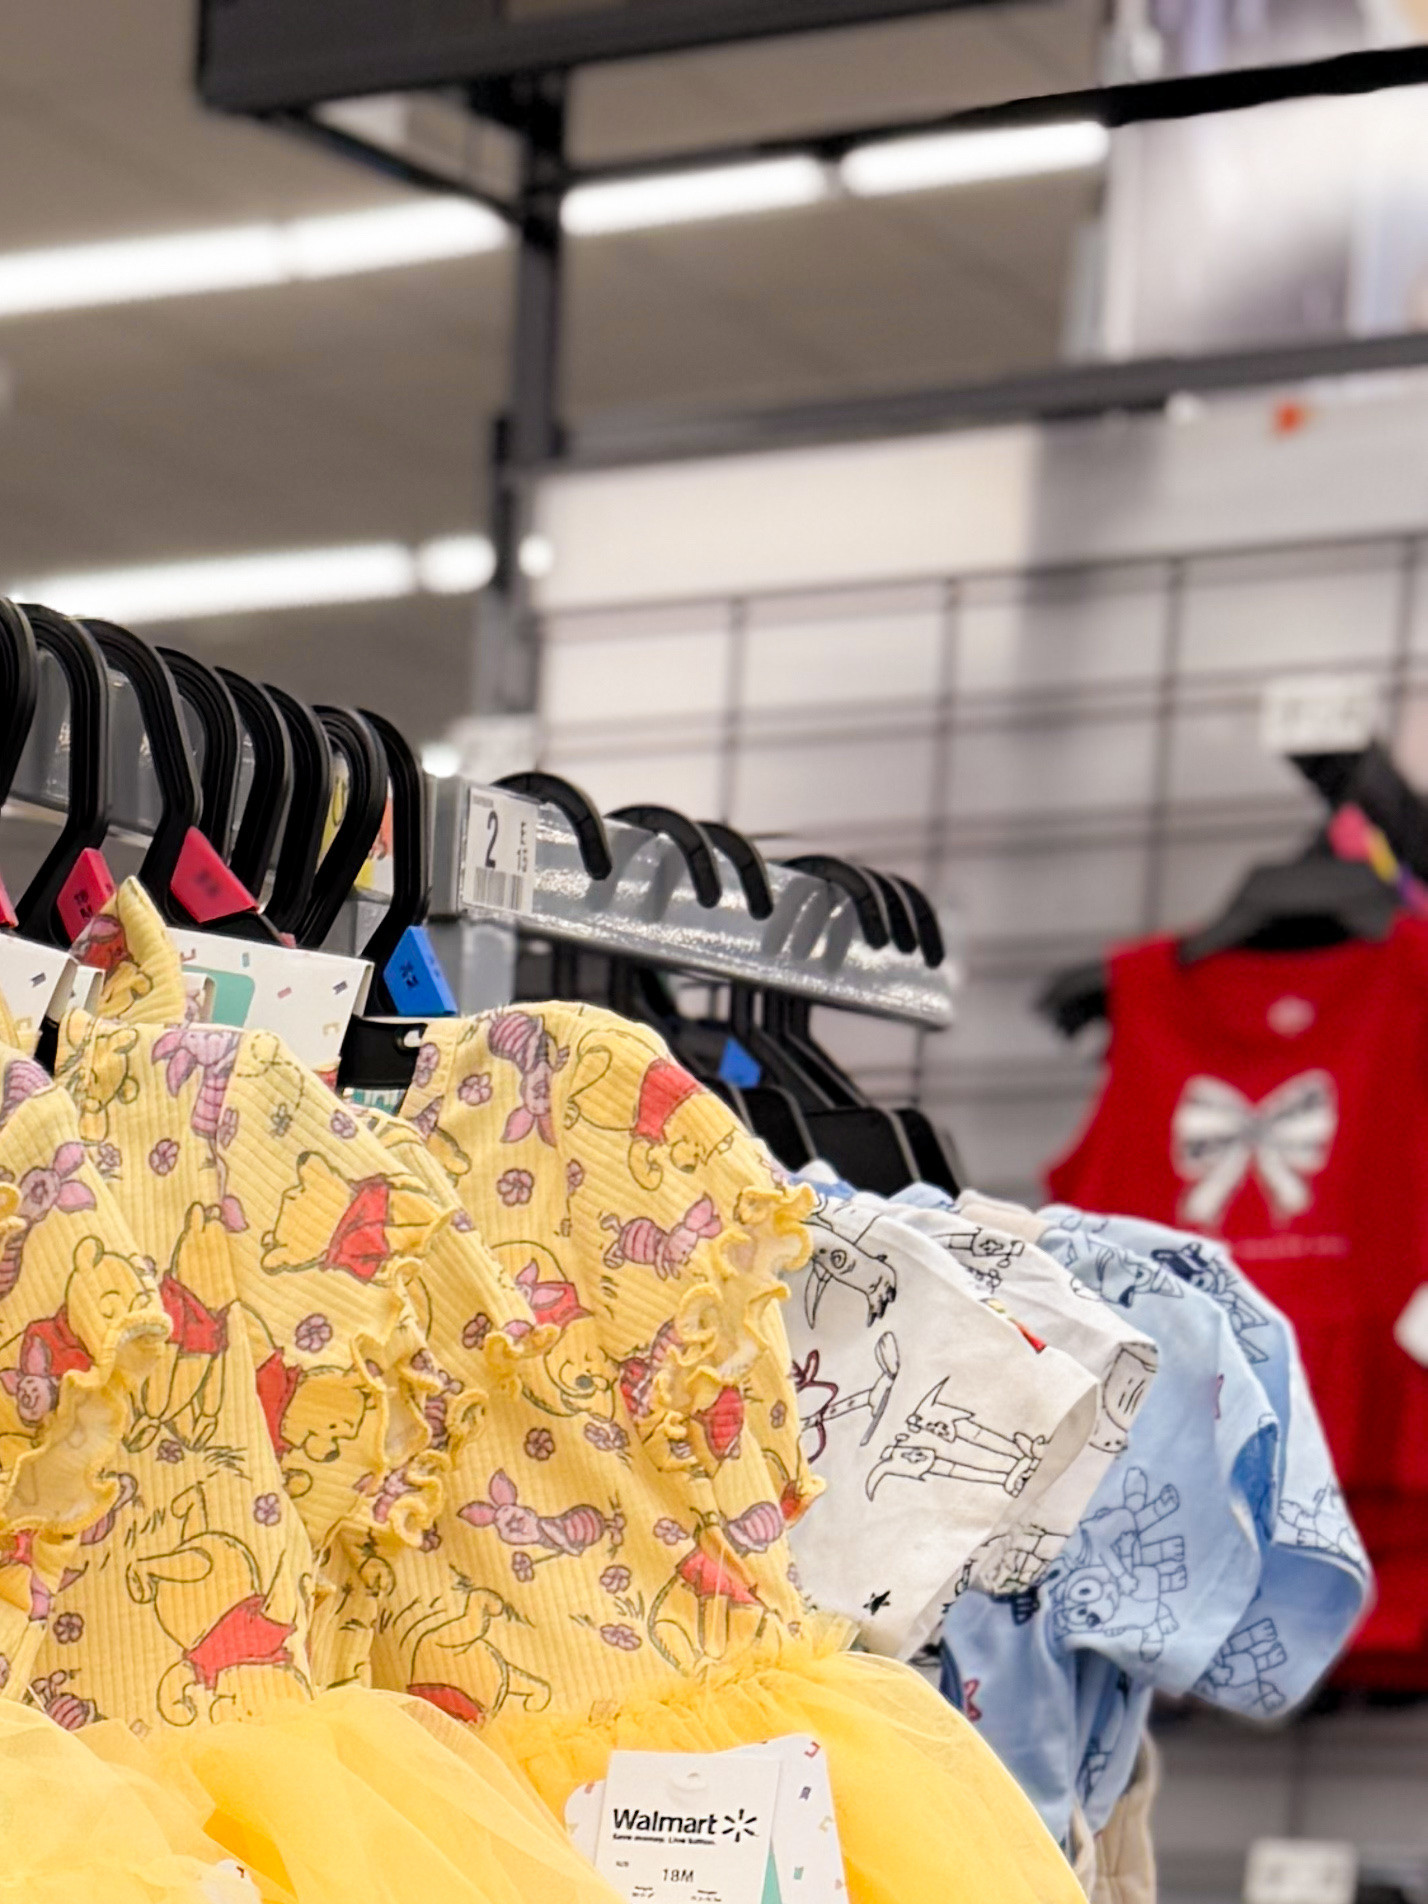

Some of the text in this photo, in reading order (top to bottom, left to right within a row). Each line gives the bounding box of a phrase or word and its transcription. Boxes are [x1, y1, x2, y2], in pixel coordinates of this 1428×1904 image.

[485, 809, 499, 869] 2
[613, 1808, 718, 1835] Walmart
[662, 1868, 694, 1883] 18M
